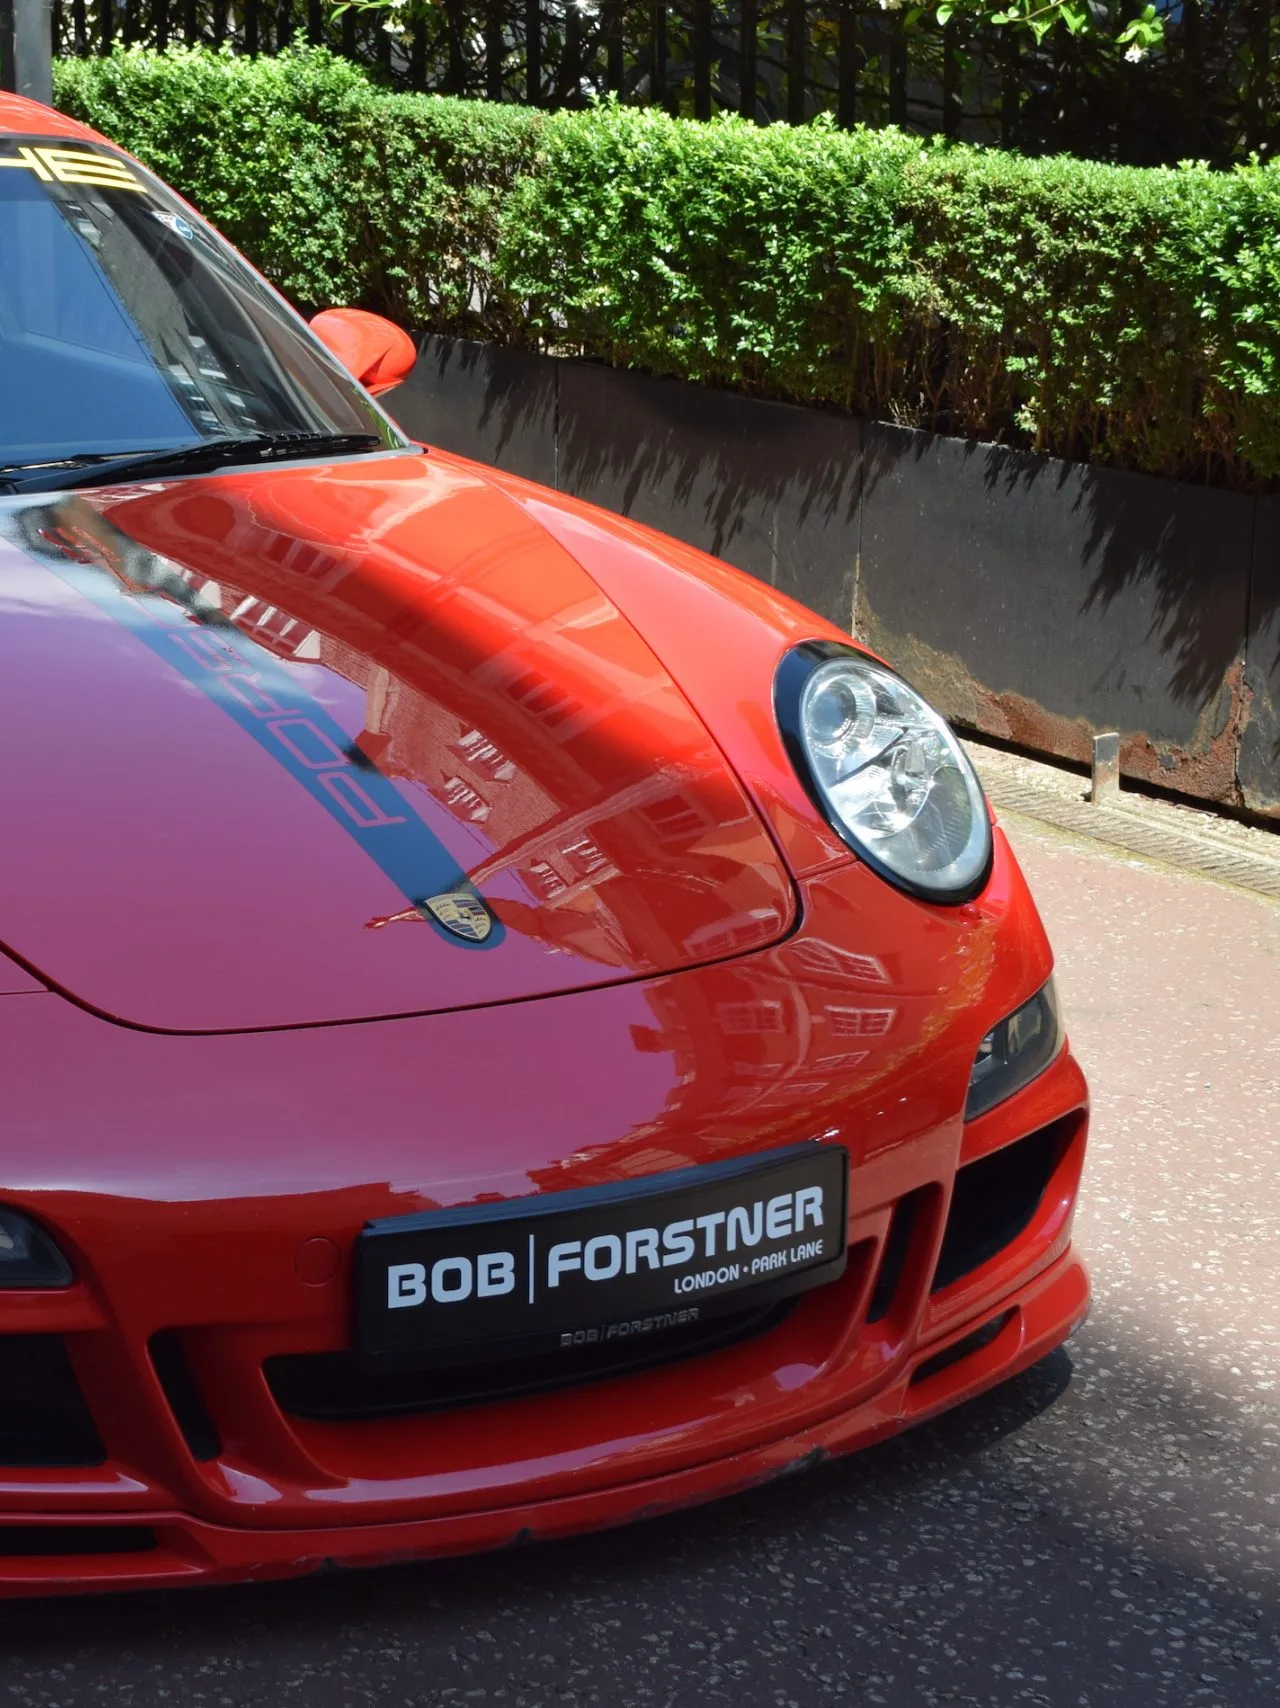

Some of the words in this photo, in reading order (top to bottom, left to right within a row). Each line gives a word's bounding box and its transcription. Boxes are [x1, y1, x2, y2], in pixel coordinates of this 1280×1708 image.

[387, 1251, 515, 1309] BOB
[547, 1186, 824, 1288] FORSTNER
[674, 1266, 740, 1294] LONDON
[751, 1251, 787, 1275] PARK
[790, 1239, 824, 1262] LANE
[560, 1329, 598, 1347] BOB
[607, 1307, 700, 1338] FORSTNER
